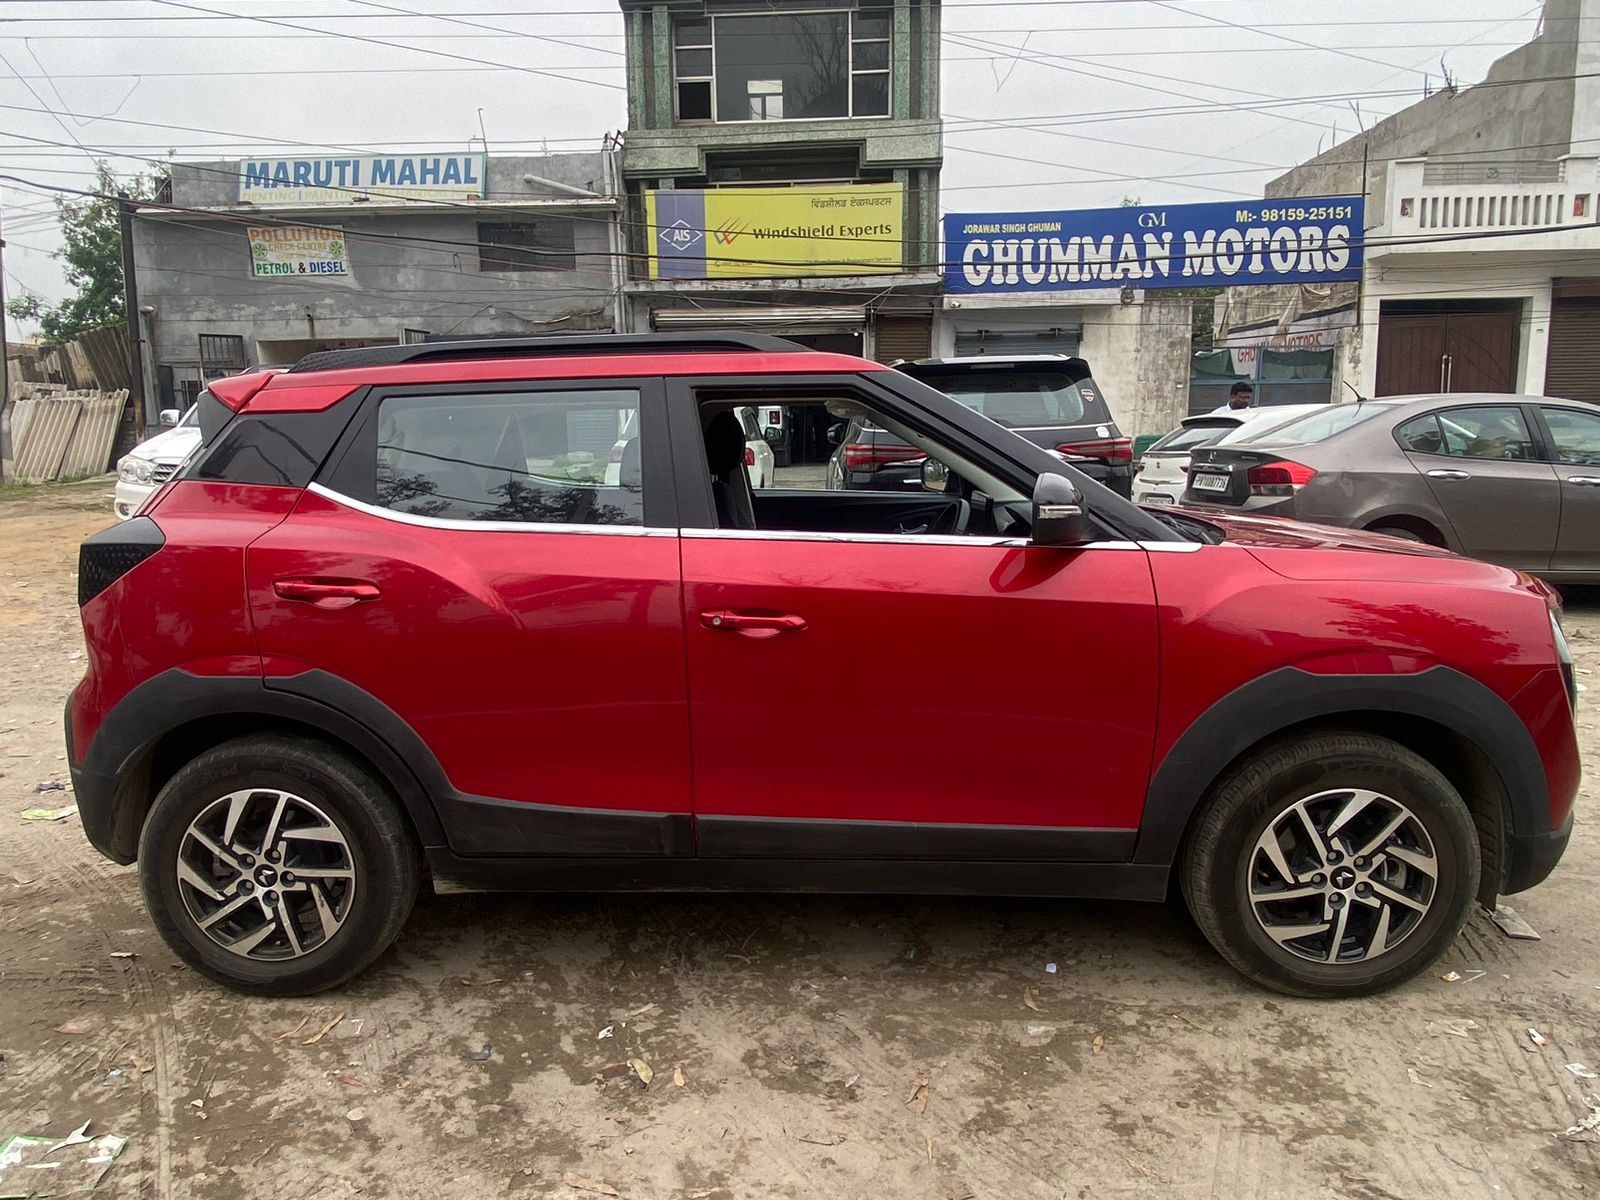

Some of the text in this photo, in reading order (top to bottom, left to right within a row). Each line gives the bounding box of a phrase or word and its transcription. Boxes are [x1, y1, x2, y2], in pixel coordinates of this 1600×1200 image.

[245, 157, 478, 189] MARUTI MAHAL
[305, 189, 353, 200] PAINTIN
[1261, 206, 1353, 222] 98159-25151
[249, 228, 343, 242] POLLUTION
[673, 229, 691, 241] AIS
[753, 223, 892, 239] Windshield Experts
[963, 222, 1061, 234] JORAWAR SINGH GHUMAN
[963, 224, 1350, 287] GHUMMAN MOTORS
[256, 261, 346, 275] PETROL & DIESEL
